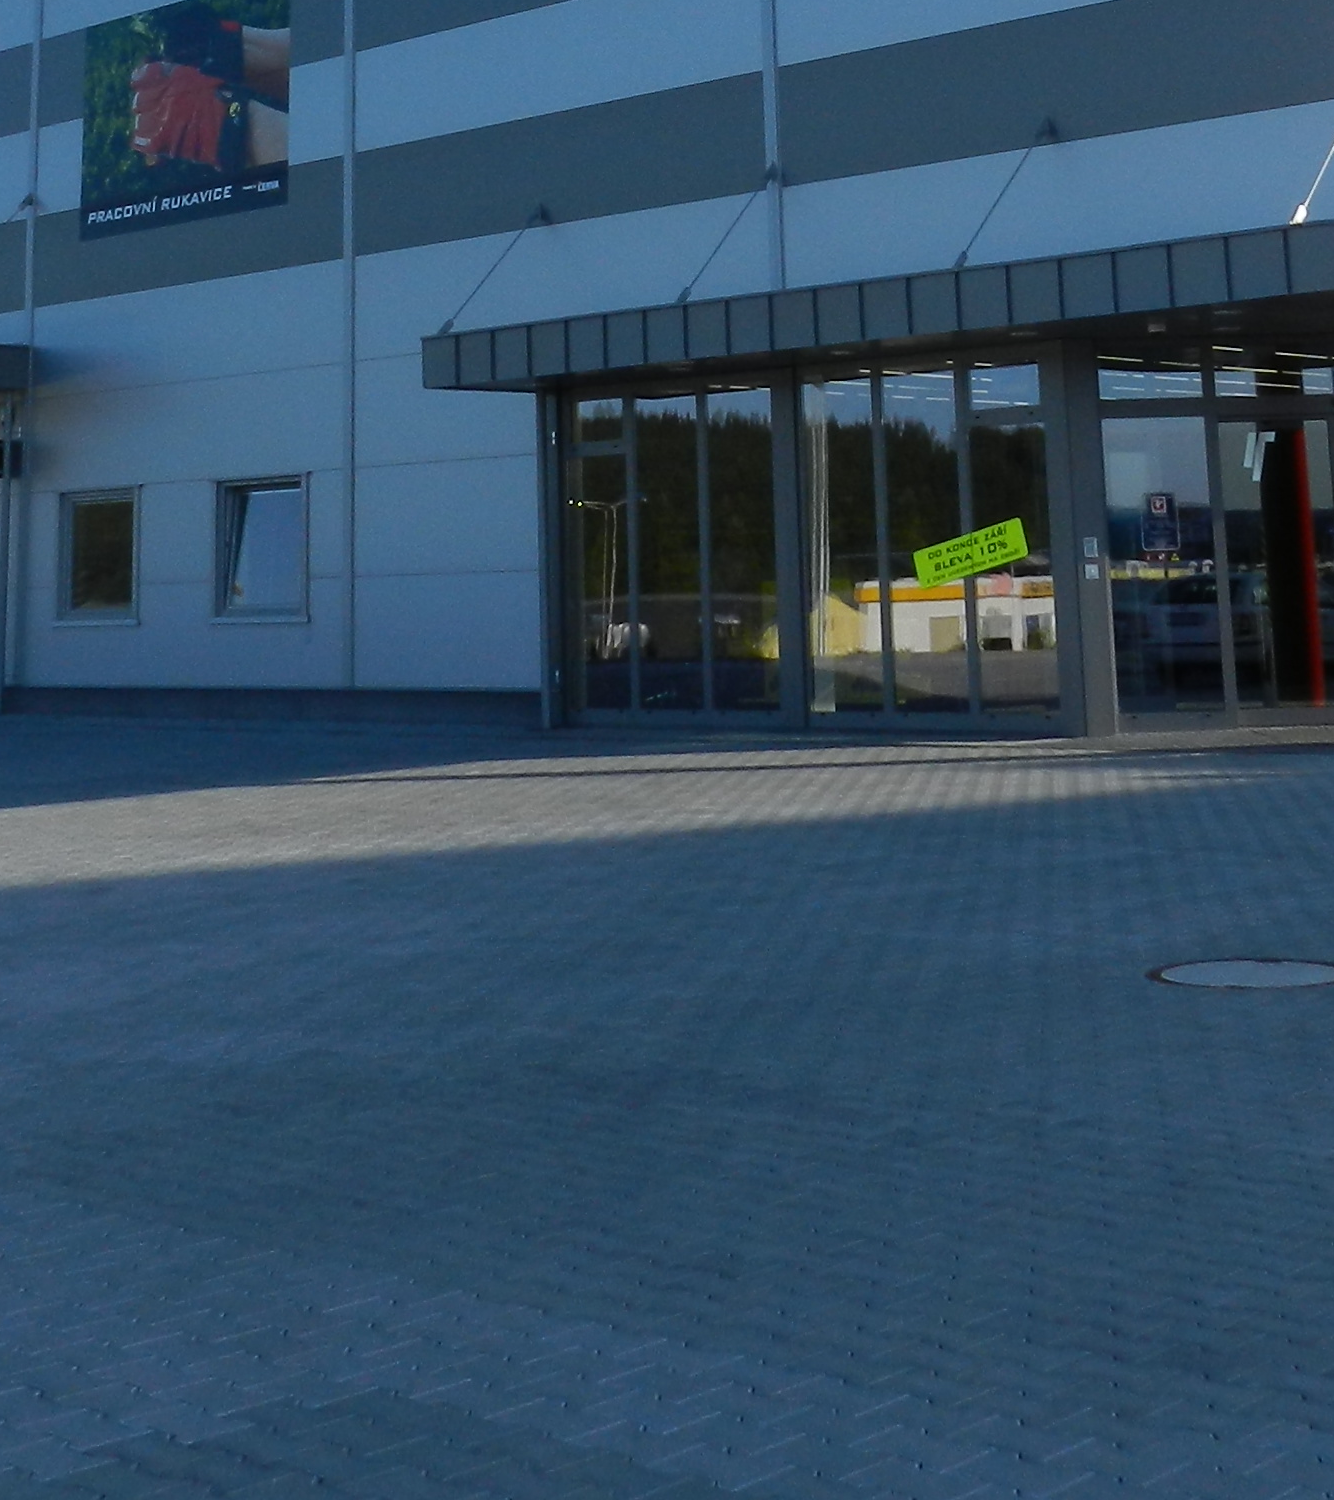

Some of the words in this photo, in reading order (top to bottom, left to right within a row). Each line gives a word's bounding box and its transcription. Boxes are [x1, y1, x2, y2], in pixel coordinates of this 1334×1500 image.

[87, 196, 157, 224] PRACOVNÍ
[160, 185, 233, 212] RUKAVICE
[934, 553, 972, 571] SLEVA
[980, 540, 1008, 556] 10%
